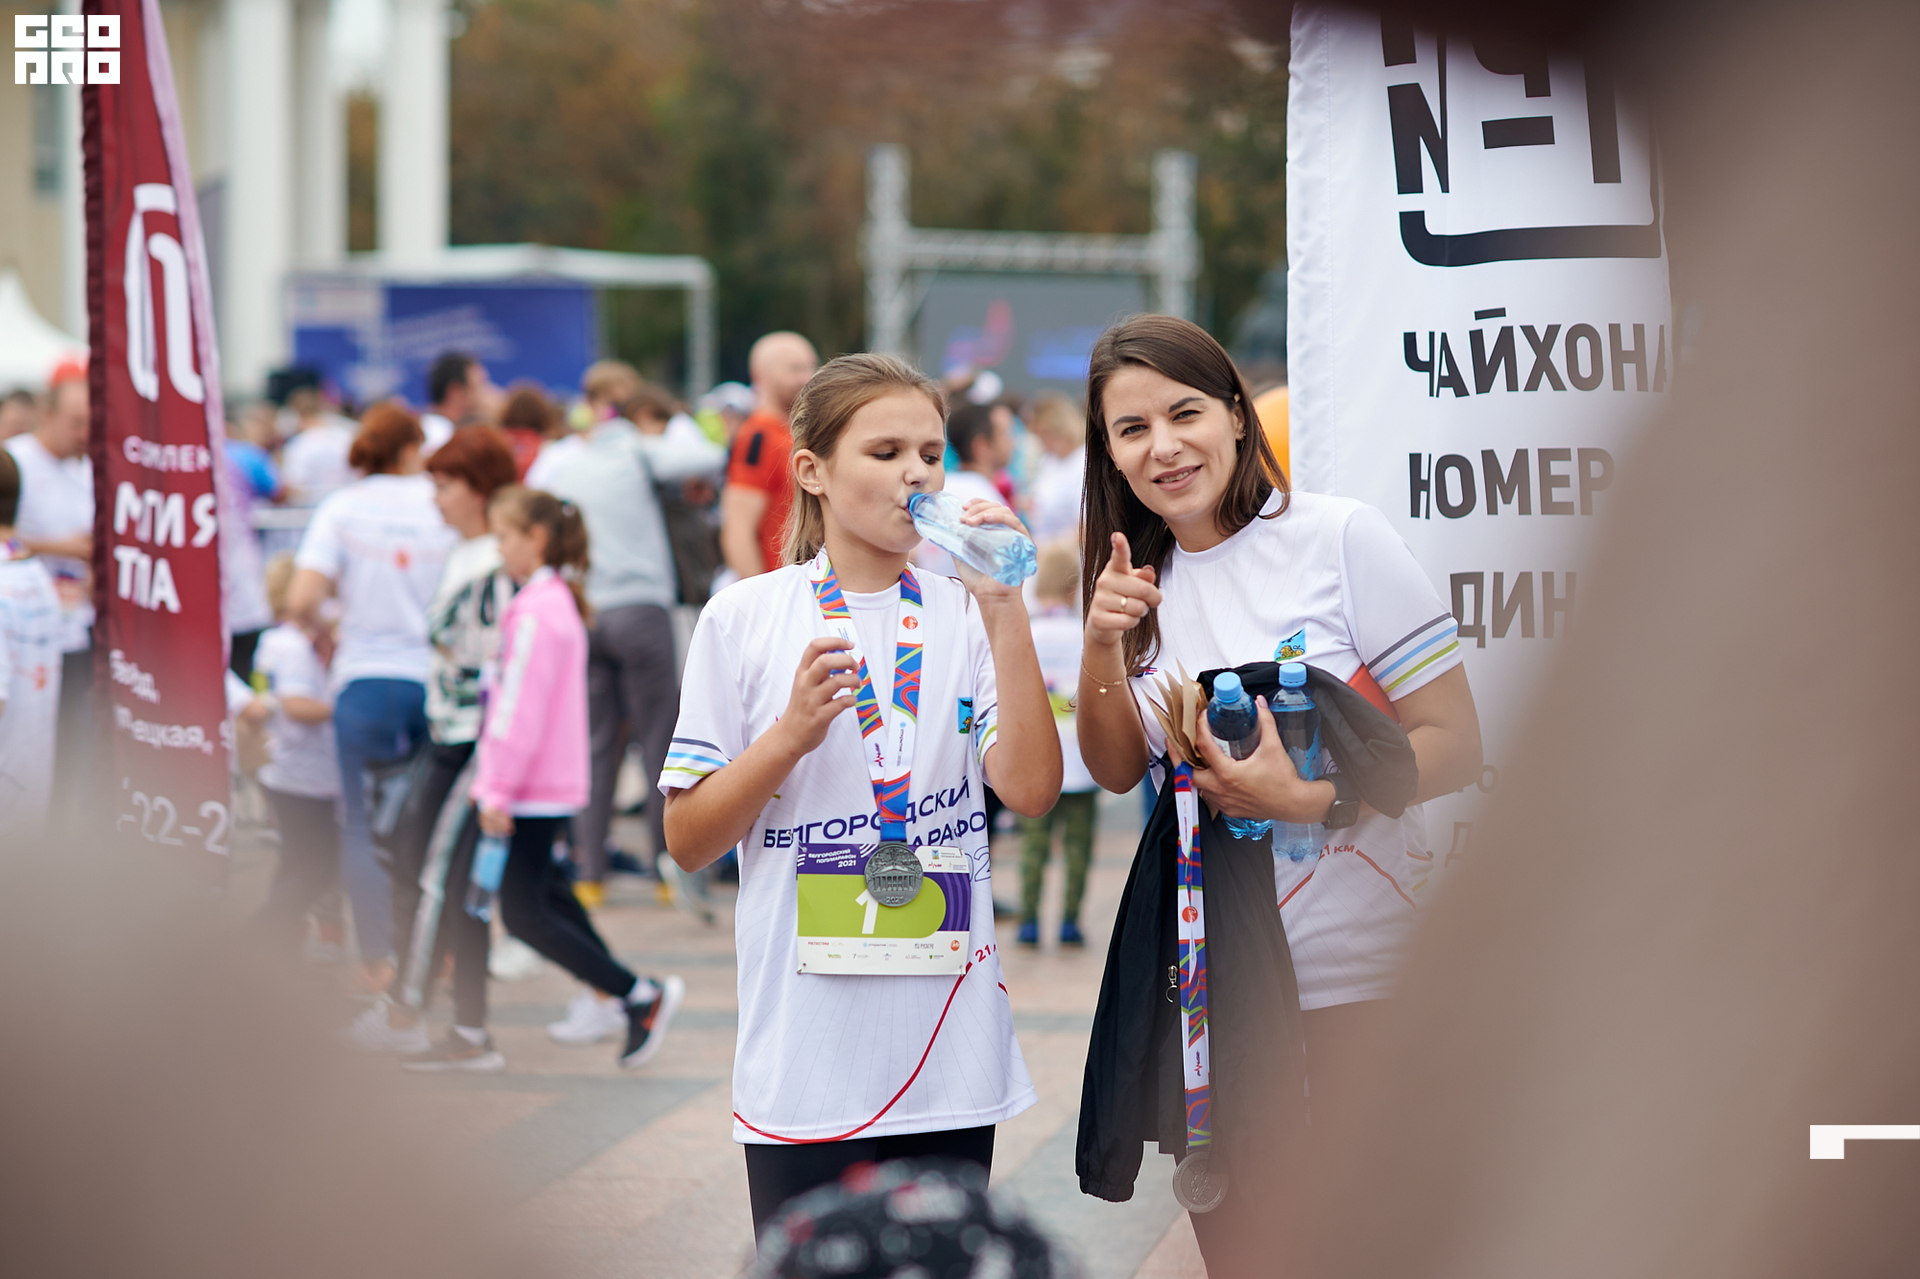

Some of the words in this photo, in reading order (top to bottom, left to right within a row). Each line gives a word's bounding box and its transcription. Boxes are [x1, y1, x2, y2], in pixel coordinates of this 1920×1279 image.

[1409, 448, 1615, 520] НОМЕР
[1449, 571, 1577, 648] ДИН
[837, 860, 857, 868] 2021
